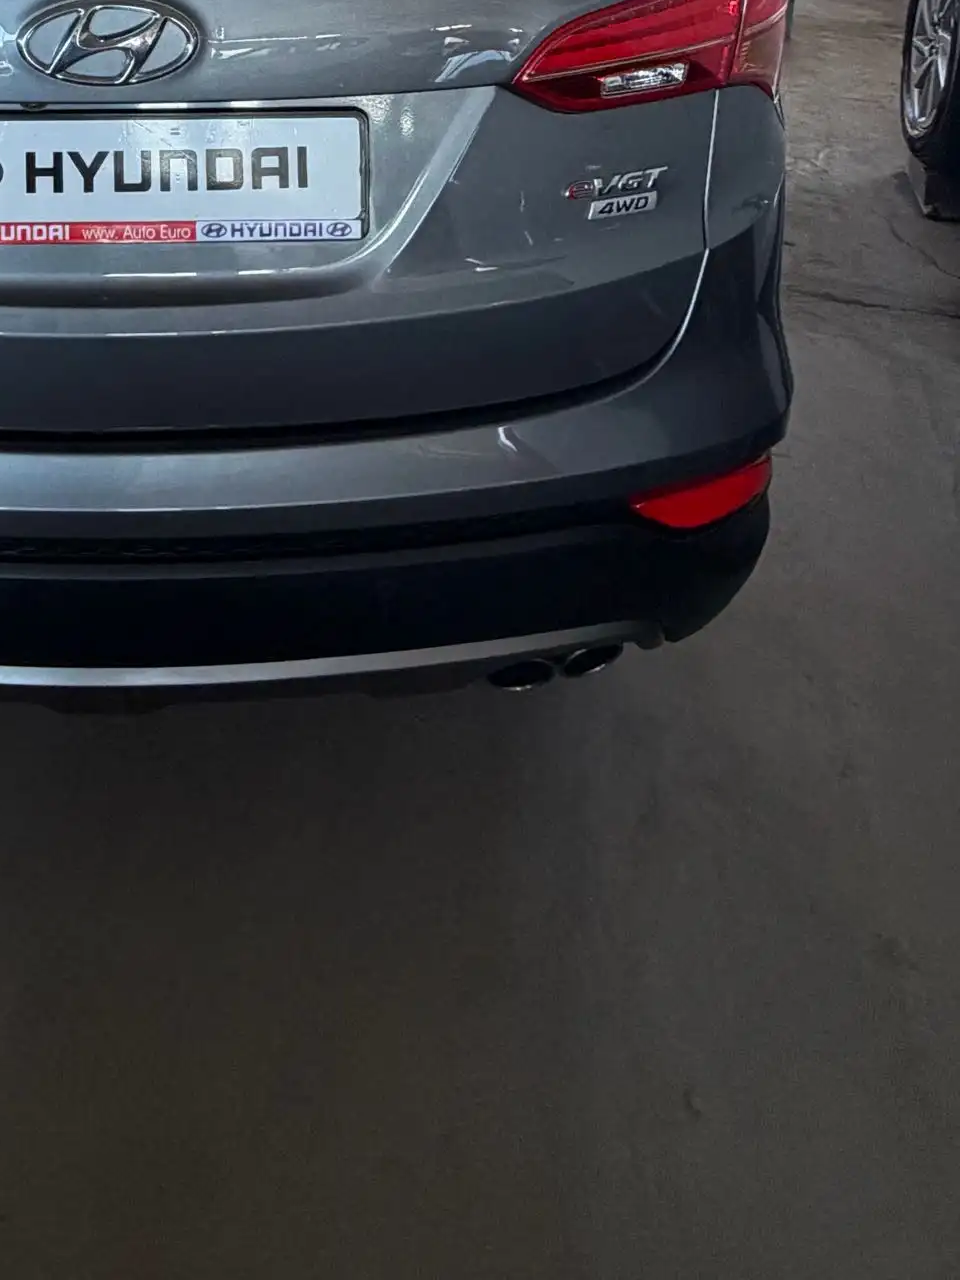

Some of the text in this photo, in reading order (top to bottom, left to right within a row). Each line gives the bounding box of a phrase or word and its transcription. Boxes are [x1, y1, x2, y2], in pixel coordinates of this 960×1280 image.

[25, 146, 308, 194] HYUNDAI
[598, 196, 650, 215] 4WD
[123, 224, 157, 239] Auto
[160, 224, 191, 239] Euro
[231, 222, 323, 237] HYUNDAI
